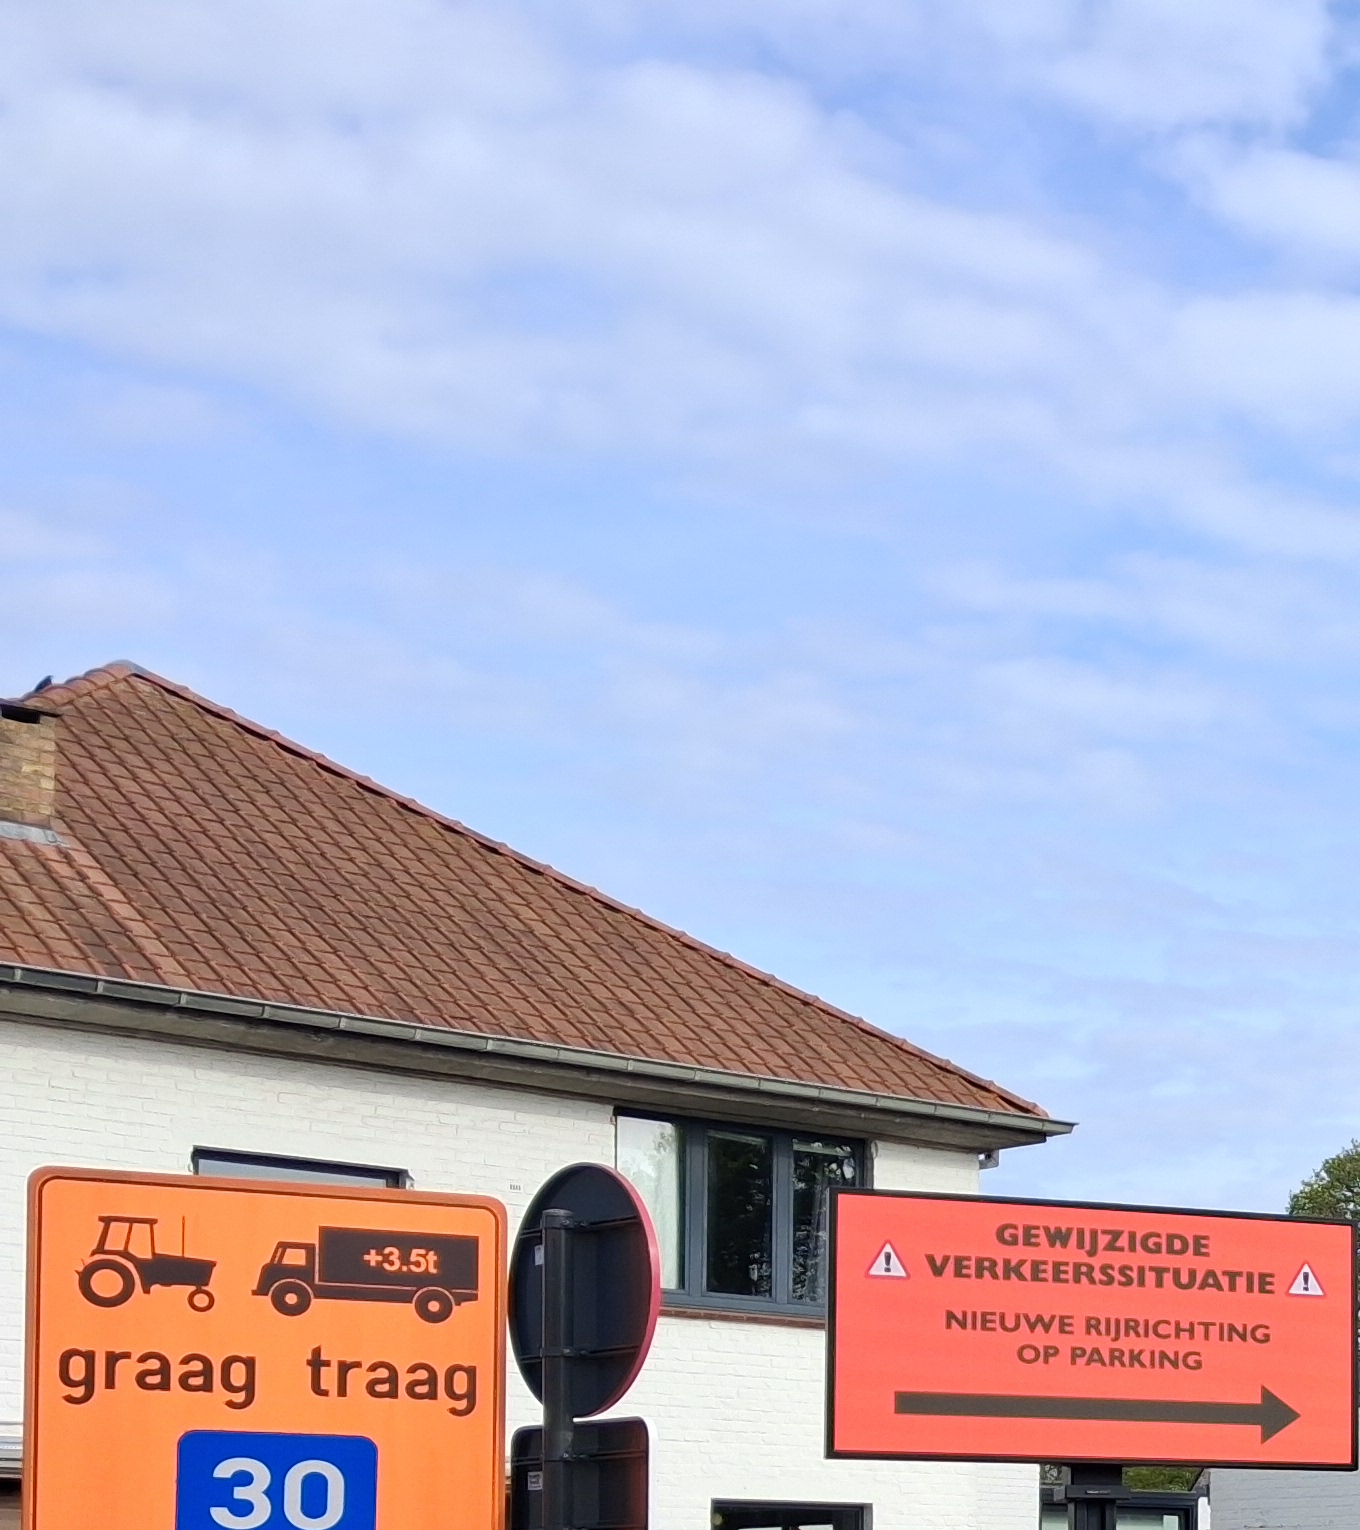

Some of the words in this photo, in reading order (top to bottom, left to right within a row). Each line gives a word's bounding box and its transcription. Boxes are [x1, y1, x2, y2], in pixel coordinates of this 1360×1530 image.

[995, 1222, 1211, 1259] GEWIJZIGDE
[362, 1245, 440, 1276] +3.5t
[924, 1253, 1276, 1296] VERKEERSSITUATIE
[945, 1309, 1075, 1336] NIEUWE
[1084, 1315, 1272, 1346] RIJRICHTING
[1016, 1343, 1061, 1366] OP
[1069, 1345, 1204, 1372] PARKING
[58, 1348, 257, 1411] graag
[306, 1345, 478, 1418] traag
